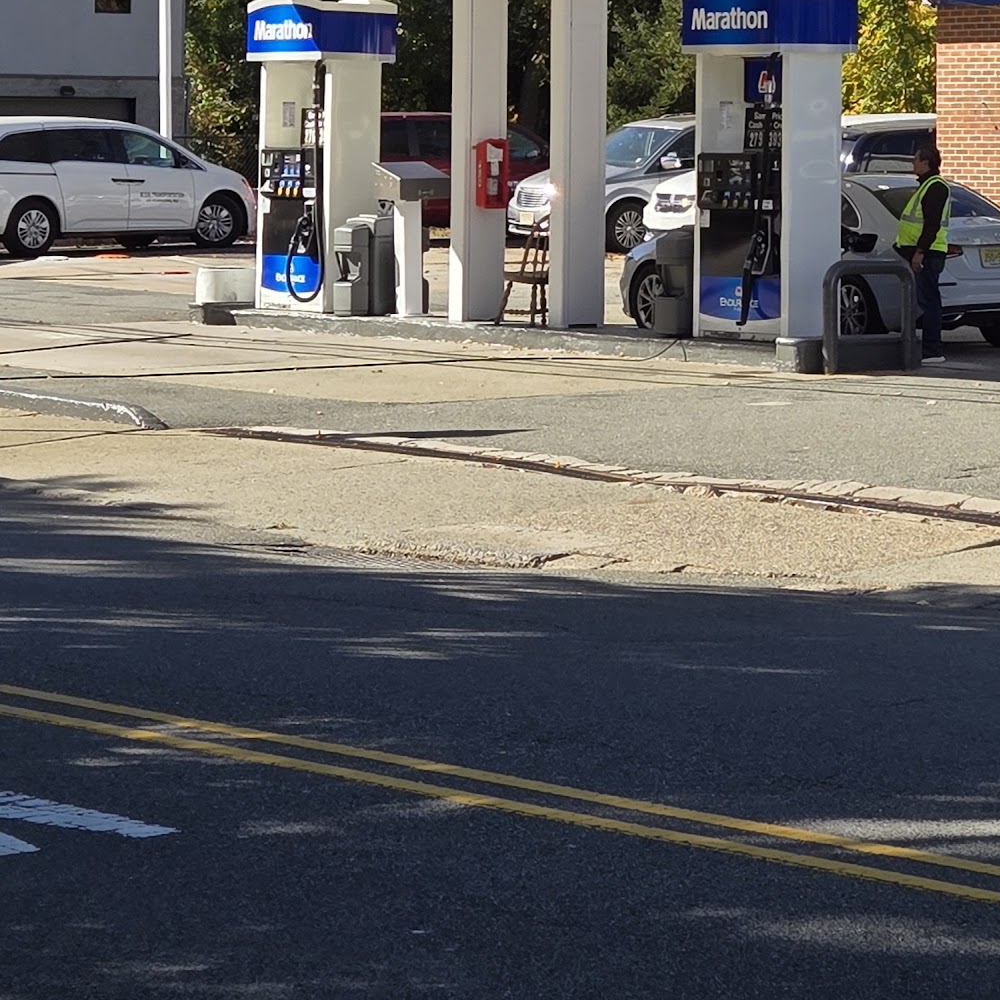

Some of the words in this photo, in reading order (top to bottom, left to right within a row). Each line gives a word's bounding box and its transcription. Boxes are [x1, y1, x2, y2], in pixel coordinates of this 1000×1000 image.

[254, 19, 313, 41] Marathon
[691, 7, 768, 31] Marathon
[719, 297, 759, 309] ENDURCE
